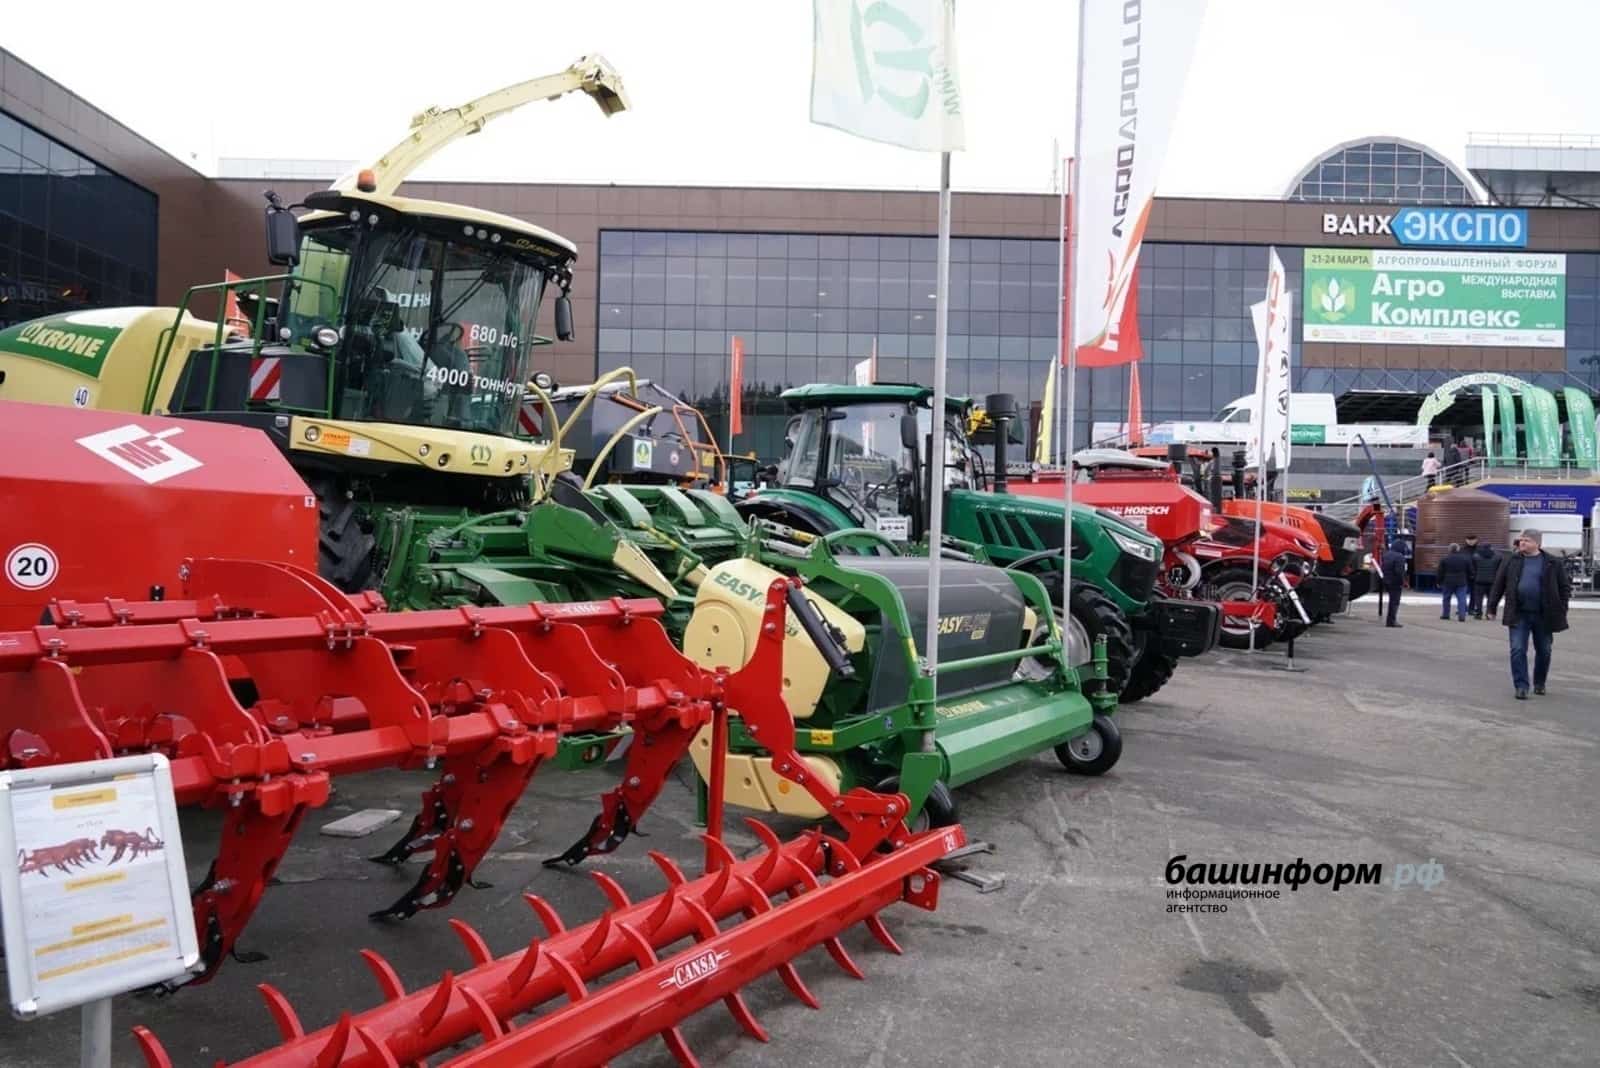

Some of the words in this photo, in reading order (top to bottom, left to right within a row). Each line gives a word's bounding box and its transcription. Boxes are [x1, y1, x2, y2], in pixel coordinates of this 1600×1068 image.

[1323, 213, 1392, 236] ВДНХ
[1403, 211, 1521, 243] ЭКСПО
[1311, 254, 1336, 264] 21-24
[1338, 255, 1370, 265] МАРТА
[1377, 256, 1511, 269] АГРОПРОМЫШЛЕННЫЙ
[1516, 259, 1558, 269] ФОРУМ
[1371, 273, 1445, 300] Агро
[1461, 275, 1557, 288] МЕЖДУНАРОДНАЯ
[1502, 289, 1557, 299] ВЫСТАВКА
[1371, 302, 1521, 328] Комплекс
[34, 327, 105, 359] KRONE
[470, 324, 497, 344] 680
[425, 366, 470, 387] 4000
[75, 388, 88, 406] 40
[1124, 505, 1170, 516] HORSCH
[17, 556, 48, 577] 20
[714, 570, 763, 602] EASY
[676, 953, 716, 985] CANSA
